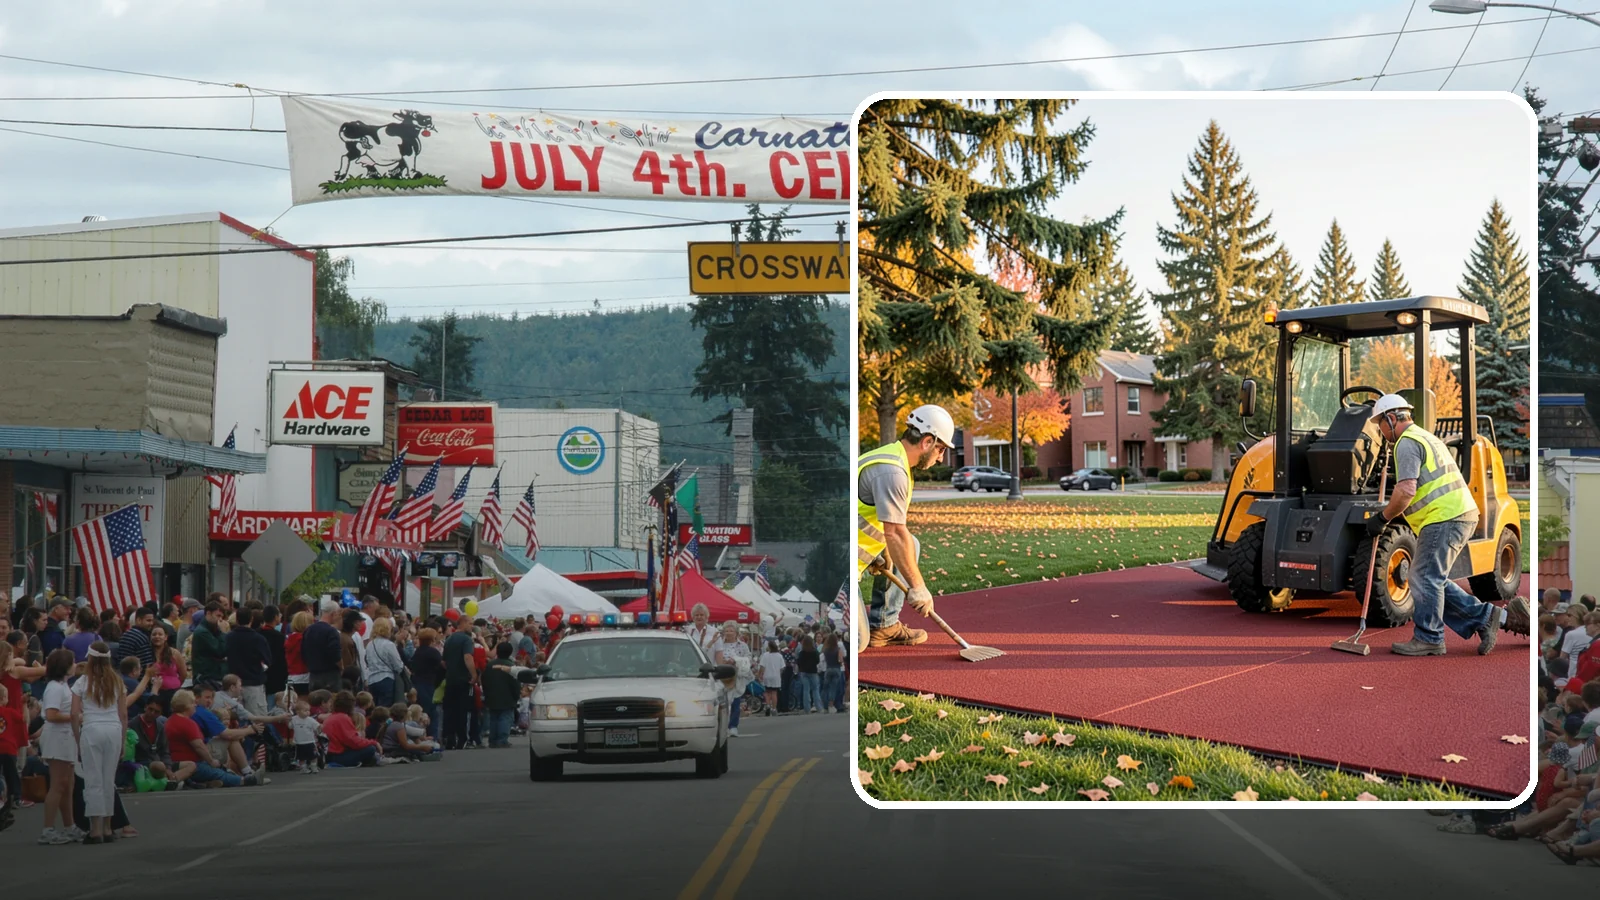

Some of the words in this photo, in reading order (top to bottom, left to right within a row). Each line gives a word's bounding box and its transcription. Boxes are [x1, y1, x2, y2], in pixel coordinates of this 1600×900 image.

[481, 141, 604, 192] JULY
[632, 150, 746, 198] 4th.
[697, 255, 850, 280] CROSSWA
[283, 380, 373, 420] ACE
[406, 410, 452, 422] CEDAR
[461, 410, 485, 422] LOG
[284, 421, 371, 437] Hardware
[96, 485, 124, 495] Vincent
[126, 486, 136, 495] de
[137, 486, 155, 495] Paul
[688, 526, 741, 535] CRNATION
[699, 535, 730, 543] GLASS
